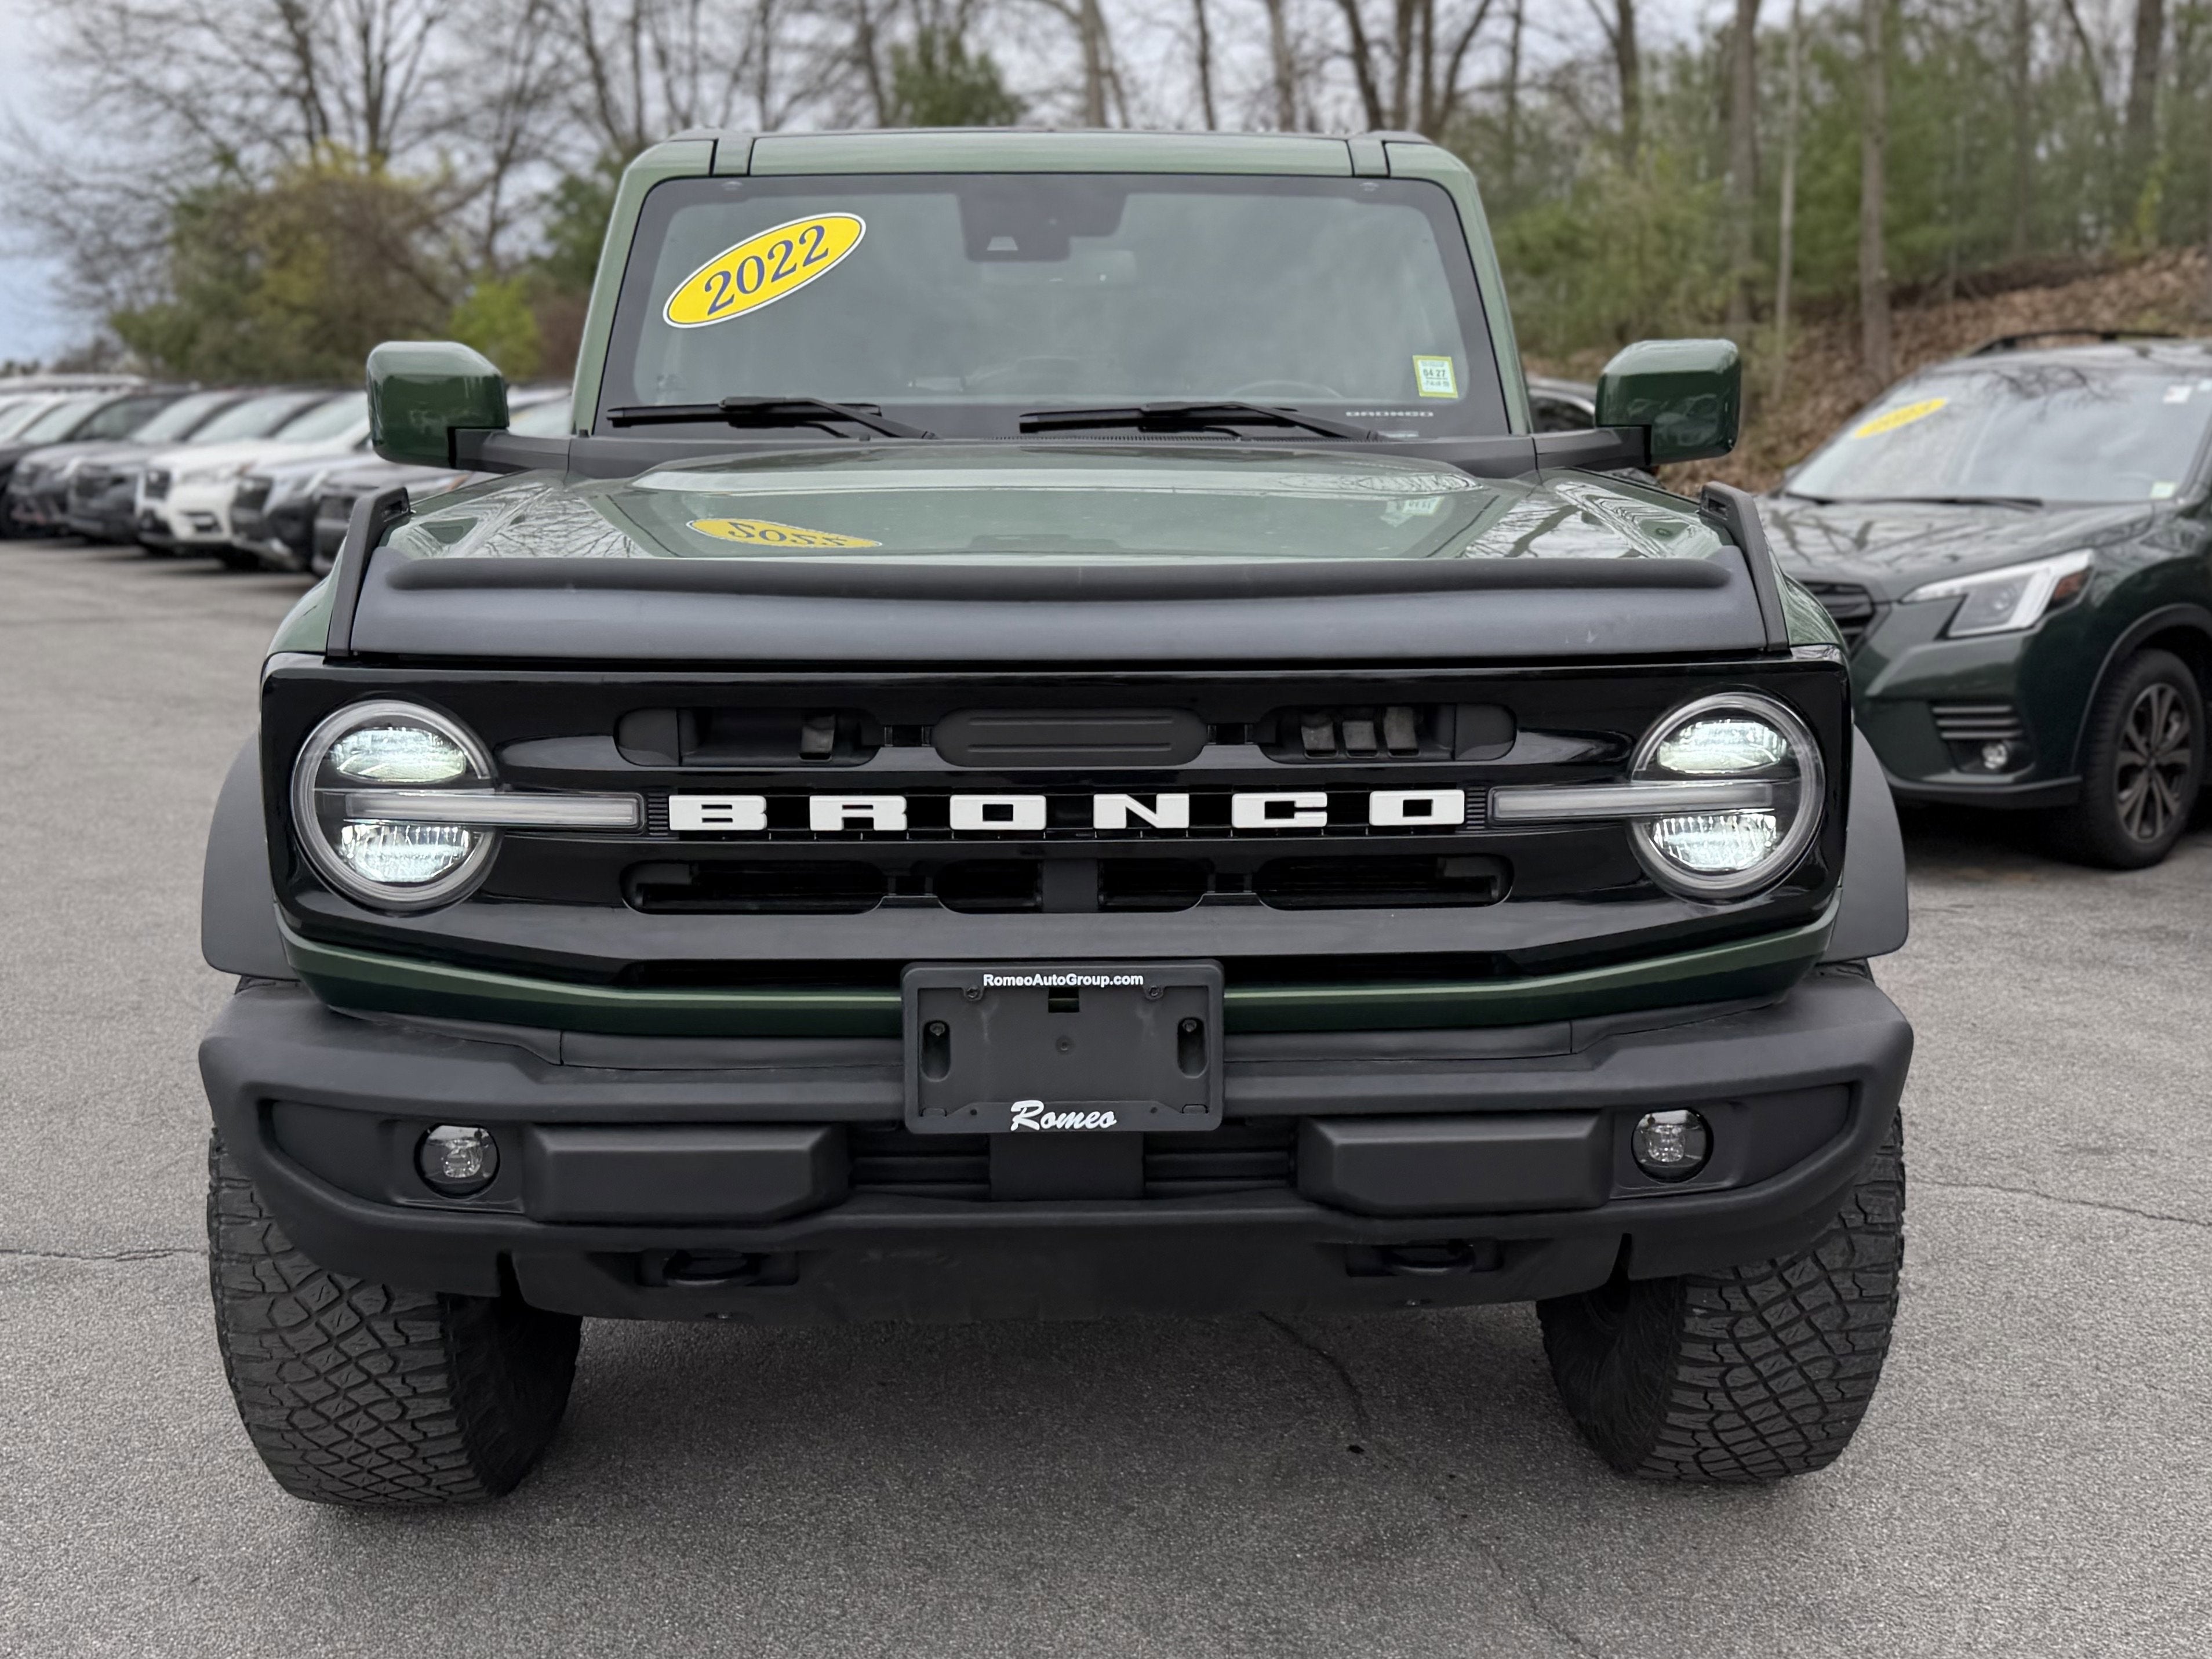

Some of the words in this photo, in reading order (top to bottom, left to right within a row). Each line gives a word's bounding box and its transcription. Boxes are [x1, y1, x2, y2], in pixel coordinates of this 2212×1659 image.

[704, 225, 829, 316] 2022
[669, 790, 1465, 832] BRONCO
[983, 973, 1144, 988] RomeoAutoGroup.com
[1010, 1100, 1118, 1132] Romeo
